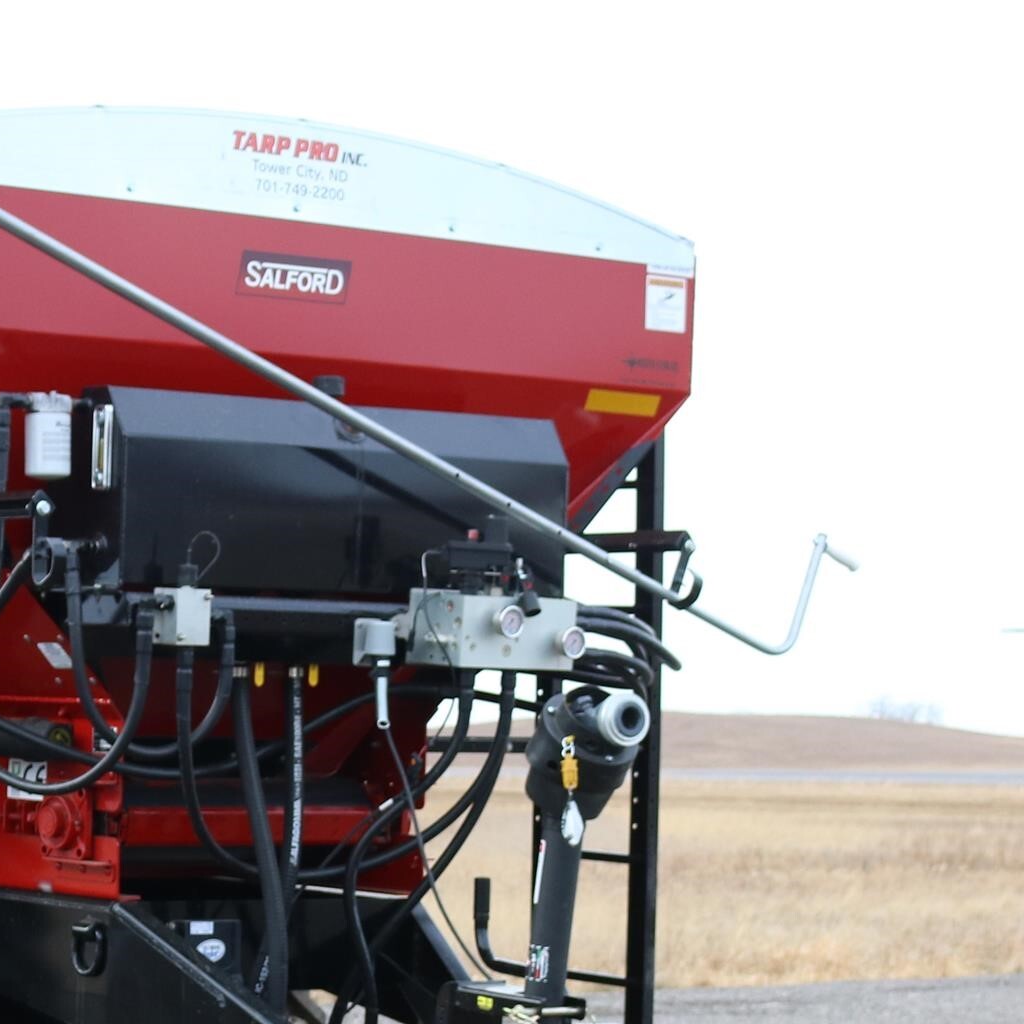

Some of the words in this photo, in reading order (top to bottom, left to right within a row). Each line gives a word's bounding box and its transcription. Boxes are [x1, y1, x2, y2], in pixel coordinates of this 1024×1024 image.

[232, 130, 291, 156] TARP
[293, 138, 339, 163] PRO
[341, 151, 368, 167] INC.
[252, 158, 291, 176] Tower
[329, 169, 349, 184] ND
[256, 178, 346, 201] 701-749-2200
[244, 259, 344, 296] SALFORD
